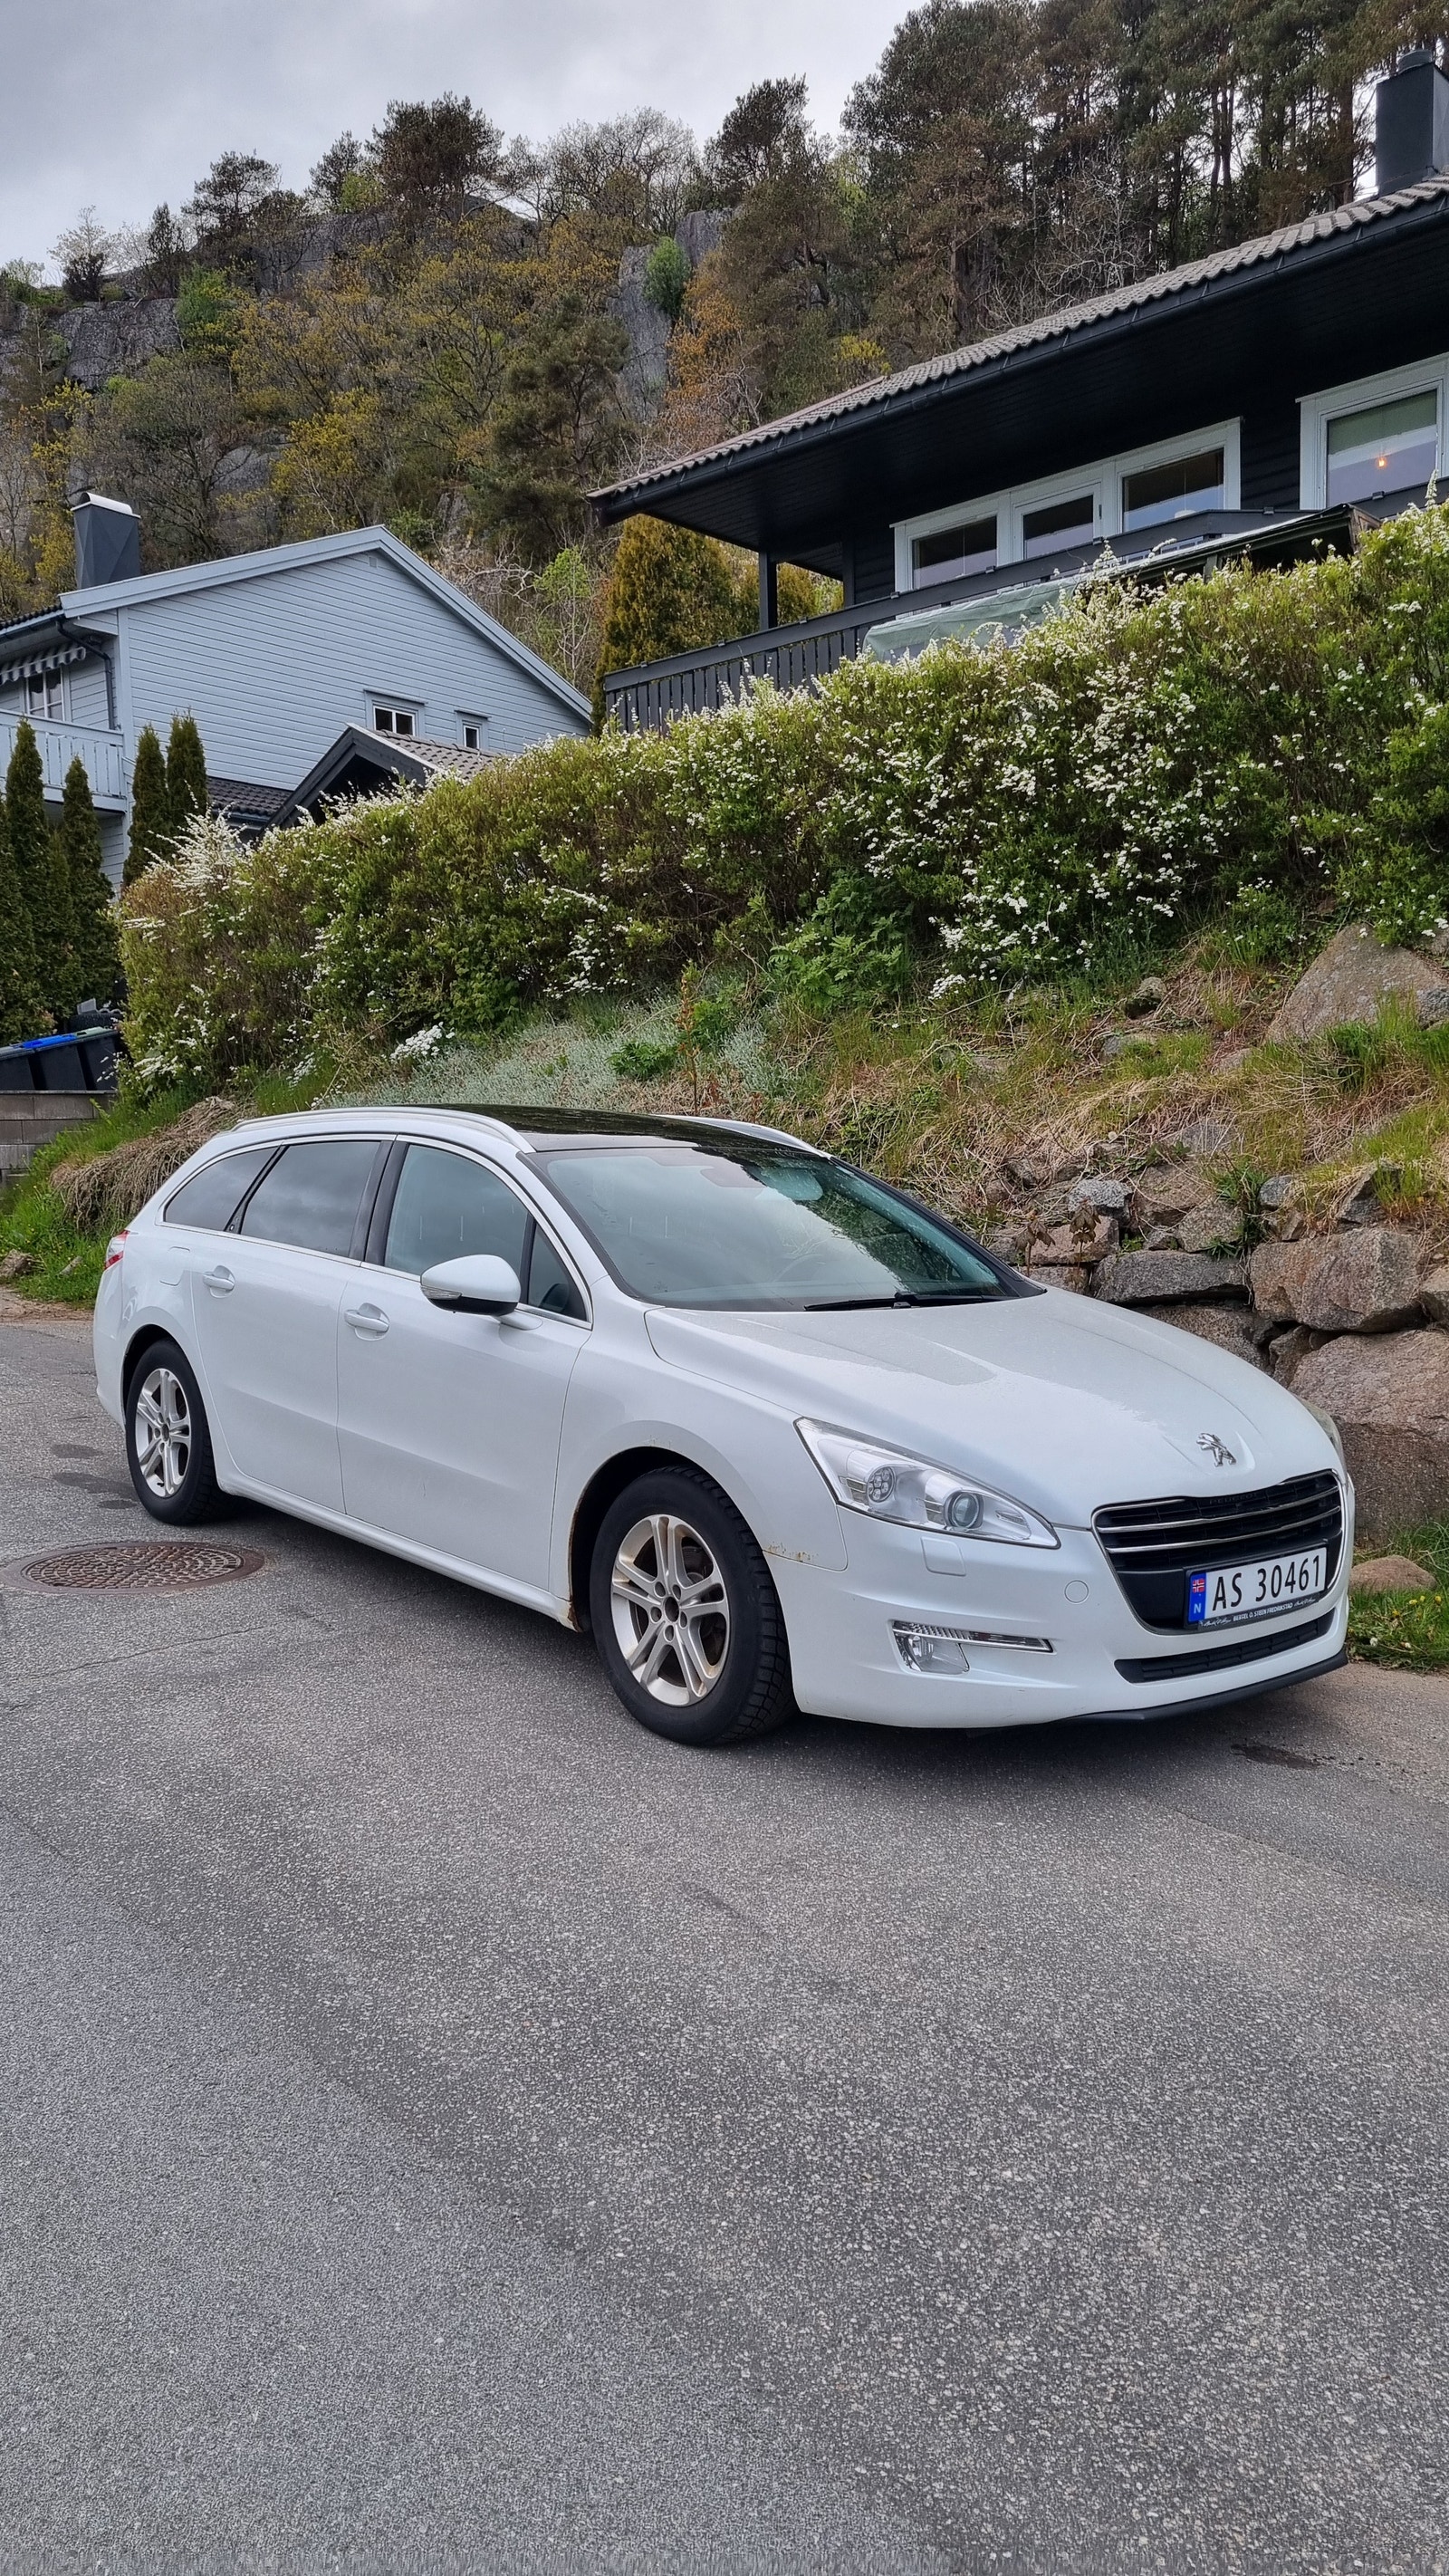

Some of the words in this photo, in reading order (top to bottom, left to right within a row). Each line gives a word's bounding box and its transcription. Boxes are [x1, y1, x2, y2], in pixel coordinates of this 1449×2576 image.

[1213, 1572, 1243, 1611] AS
[1255, 1555, 1319, 1602] 30461
[1194, 1602, 1202, 1614] N
